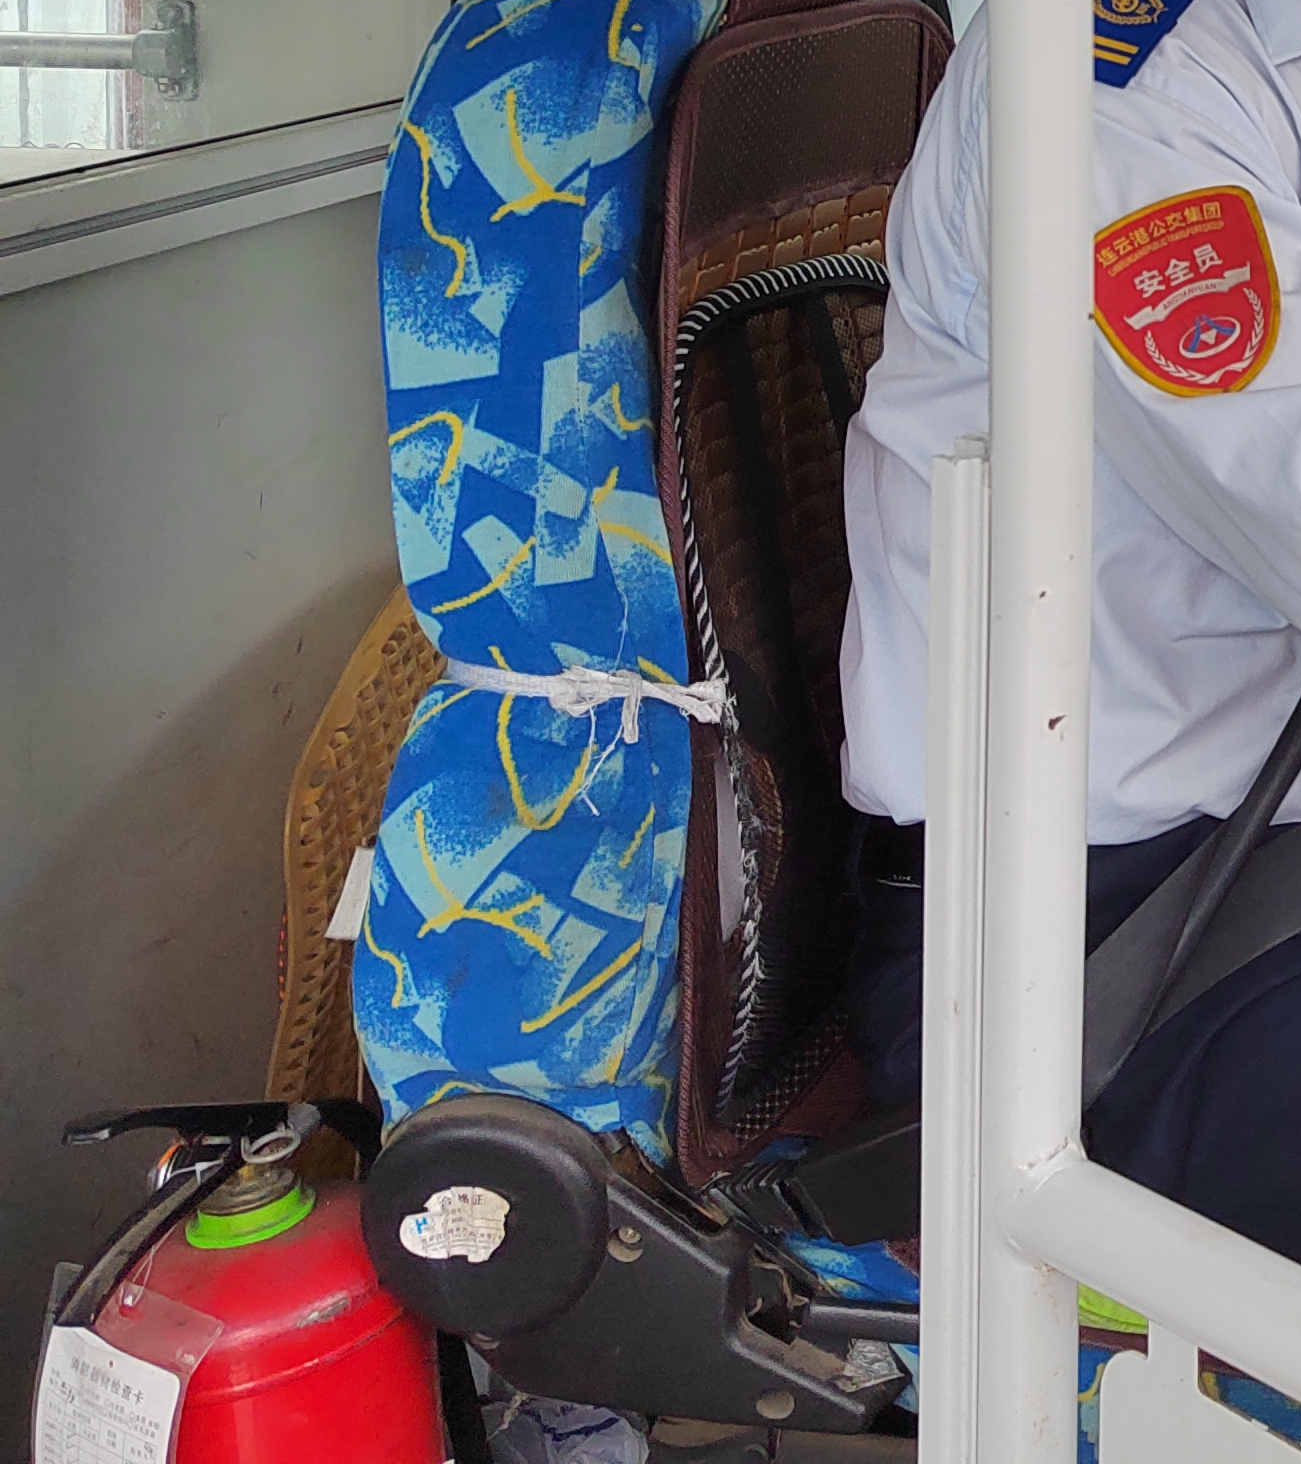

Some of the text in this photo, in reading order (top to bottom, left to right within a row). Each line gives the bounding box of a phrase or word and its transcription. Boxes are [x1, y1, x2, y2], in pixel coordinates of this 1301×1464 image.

[1096, 201, 1222, 269] 连云港公交集团
[1133, 242, 1224, 299] 安全员
